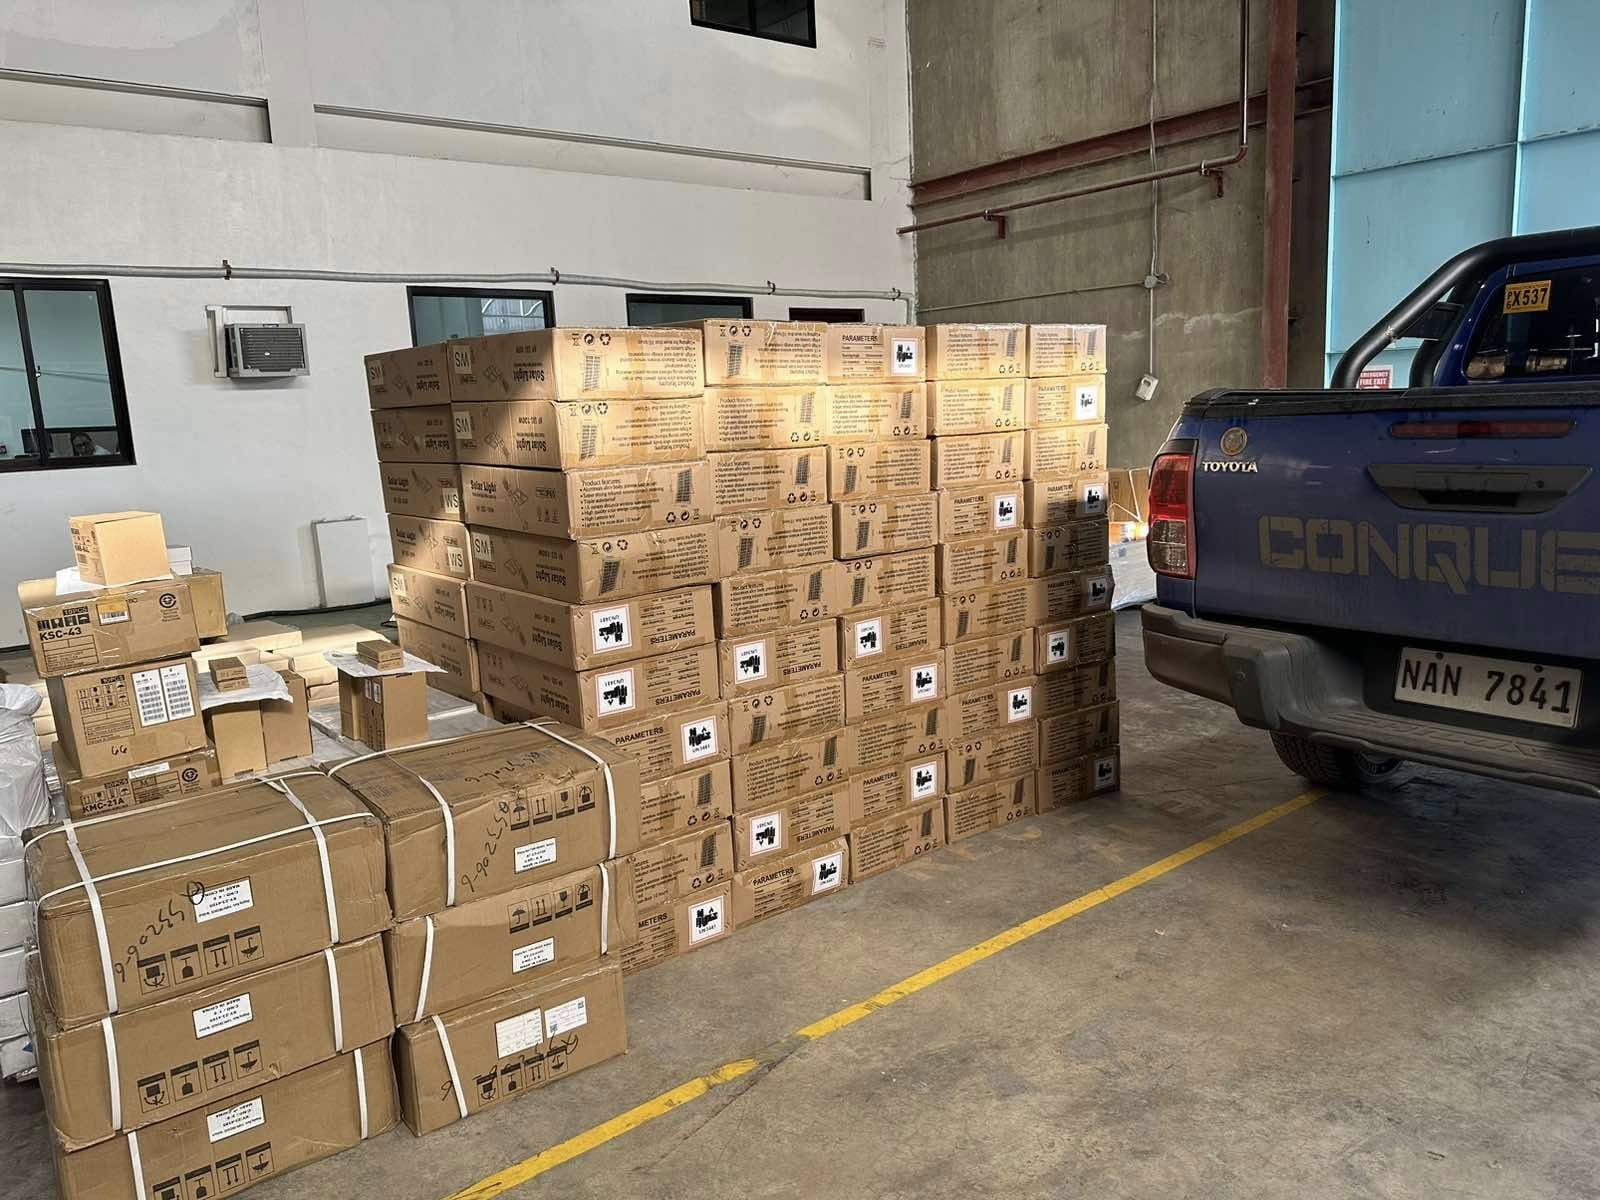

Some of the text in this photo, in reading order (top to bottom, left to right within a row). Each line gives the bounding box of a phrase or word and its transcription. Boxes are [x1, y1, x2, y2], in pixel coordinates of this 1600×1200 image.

[1512, 288, 1548, 306] X537
[842, 334, 878, 342] PARAMETERS
[513, 368, 545, 382] Solar Light
[516, 438, 547, 453] Solar Light
[1202, 461, 1258, 473] TOYOTA
[470, 479, 497, 494] Solar Light
[446, 494, 458, 508] WS
[954, 496, 984, 505] PARAMETERS
[451, 555, 464, 568] WS
[536, 569, 567, 586] Solar Light
[40, 626, 82, 641] KSC-43
[650, 630, 696, 644] PARAMETERS
[532, 634, 563, 652] Solar Light
[896, 638, 928, 650] PARAMETERS
[783, 662, 822, 676] PARAMETERS
[862, 670, 898, 682] PARAMETERS
[1401, 659, 1571, 714] NAN 7841
[655, 688, 701, 706] PARAMETERS
[962, 694, 994, 706] PARAMETERS
[615, 726, 664, 744] PARAMETERS
[863, 772, 898, 786] PARAMETERS
[82, 798, 125, 814] KMC-21A
[799, 824, 835, 842] PARAMETERS
[752, 866, 795, 887] PARAMETERS
[638, 912, 668, 929] METERS
